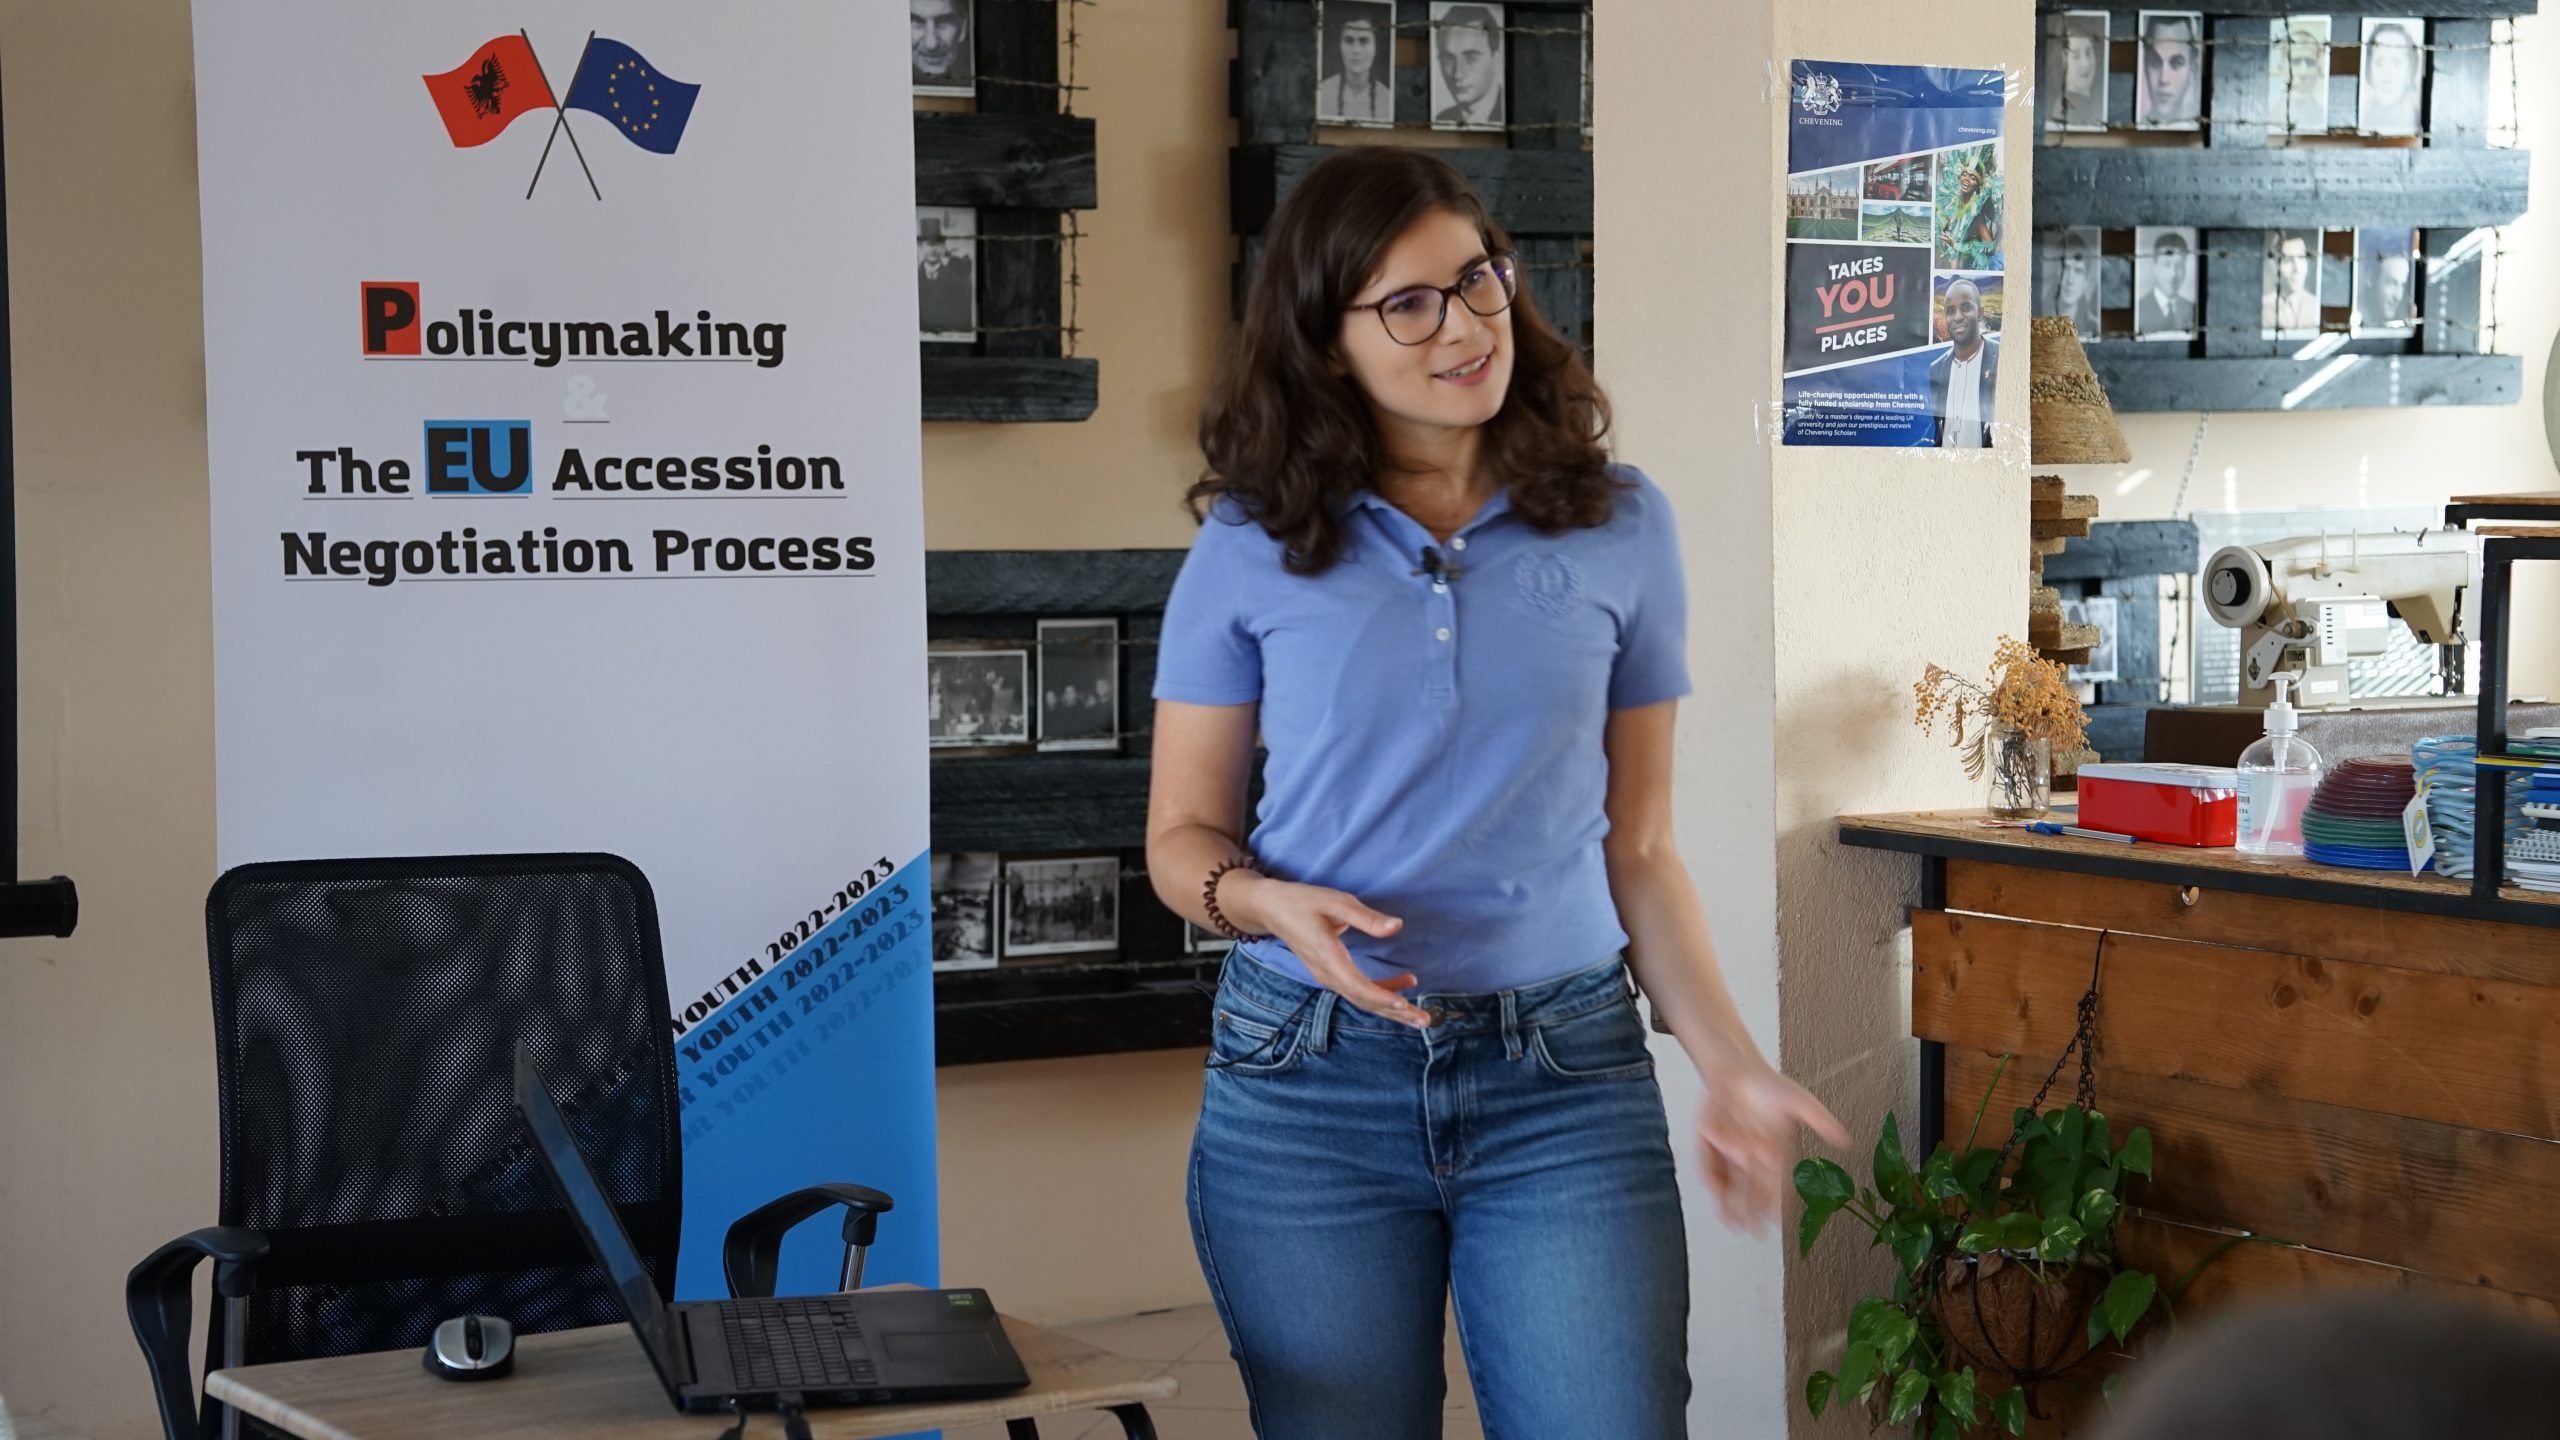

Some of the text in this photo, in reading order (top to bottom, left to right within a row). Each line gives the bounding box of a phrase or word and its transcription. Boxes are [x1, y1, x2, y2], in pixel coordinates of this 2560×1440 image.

[1799, 117, 1843, 126] CHEVENING
[1958, 126, 1996, 135] chevening.org
[1829, 256, 1884, 280] TAKES
[1816, 274, 1894, 318] YOU
[364, 286, 787, 367] Policymaking
[1821, 325, 1888, 352] PLACES
[1798, 391, 1842, 399] Life-changing
[1843, 392, 1887, 400] opportunities
[1798, 399, 1813, 408] fully
[1814, 399, 1837, 407] funded
[1838, 400, 1875, 409] scholarship
[1891, 401, 1925, 410] Chevening
[1853, 414, 1873, 422] degree
[1885, 414, 1905, 422] leading
[1804, 429, 1833, 437] Chevening
[296, 426, 845, 494] The EU Accession
[281, 527, 876, 587] Negotiation Process
[671, 856, 895, 1036] YOUTH 2022-2023
[680, 883, 910, 1064] YOUTH 2022-2023
[697, 909, 925, 1089] YOUTH 2022-2023
